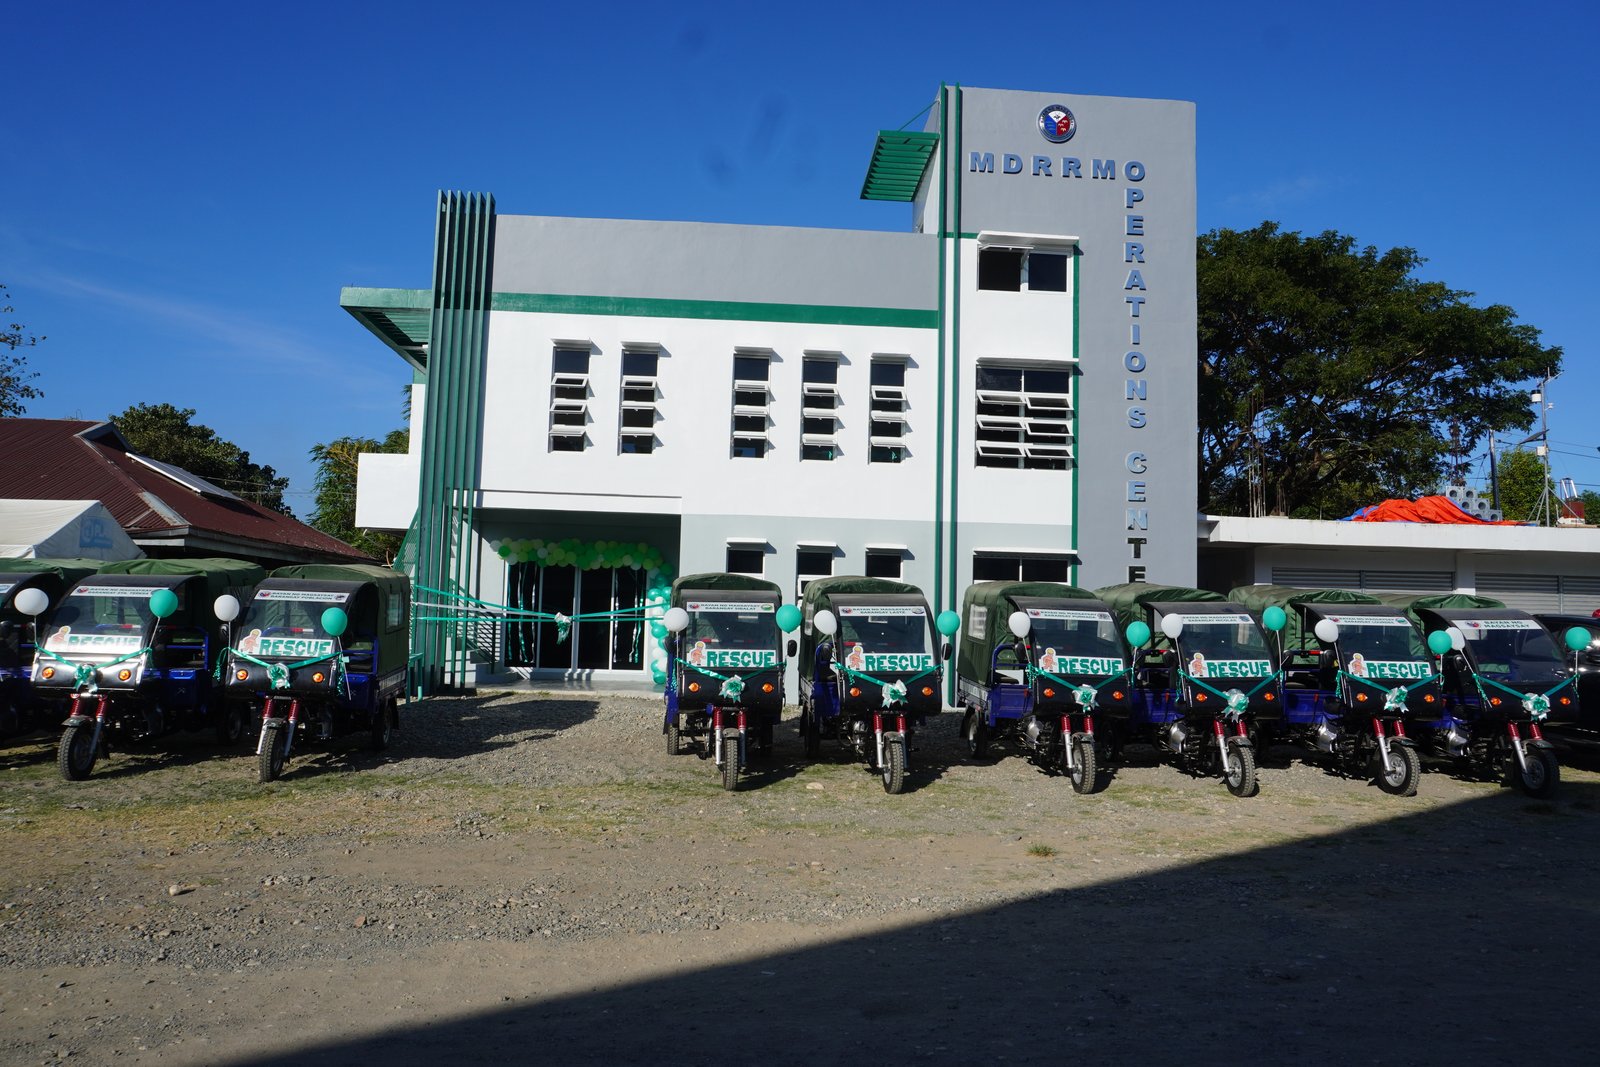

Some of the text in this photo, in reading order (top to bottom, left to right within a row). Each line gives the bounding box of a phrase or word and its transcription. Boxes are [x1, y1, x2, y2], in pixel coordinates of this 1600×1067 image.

[1123, 160, 1148, 584] OPERATIONS CENTE
[259, 638, 331, 656] RESCUE
[706, 650, 775, 667] RESCUE
[864, 654, 932, 671] RESCUE
[1057, 657, 1122, 675] RESCUE
[1206, 660, 1270, 677] RESCUE
[1365, 662, 1430, 679] RESCUE
